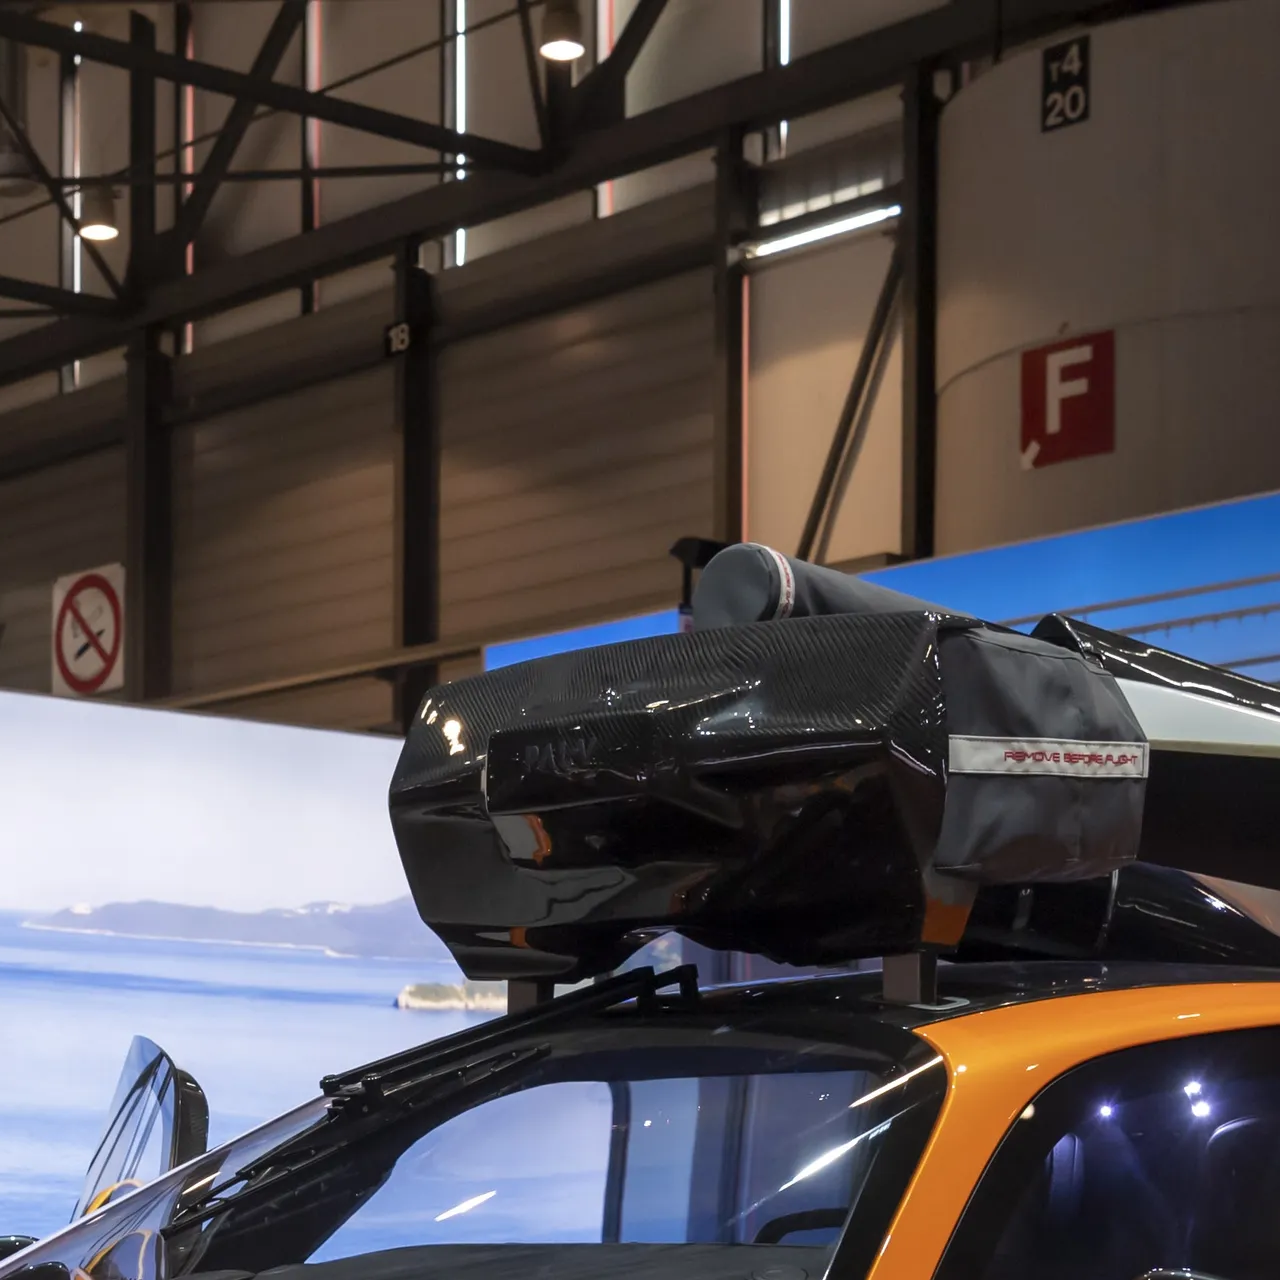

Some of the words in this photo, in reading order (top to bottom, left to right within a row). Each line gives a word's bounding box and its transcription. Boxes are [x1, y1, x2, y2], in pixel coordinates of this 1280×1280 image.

[1045, 84, 1087, 128] 20
[388, 323, 410, 353] 18
[1046, 344, 1093, 434] F
[1004, 751, 1060, 763] REMOVE
[1063, 751, 1103, 767] BEFORE
